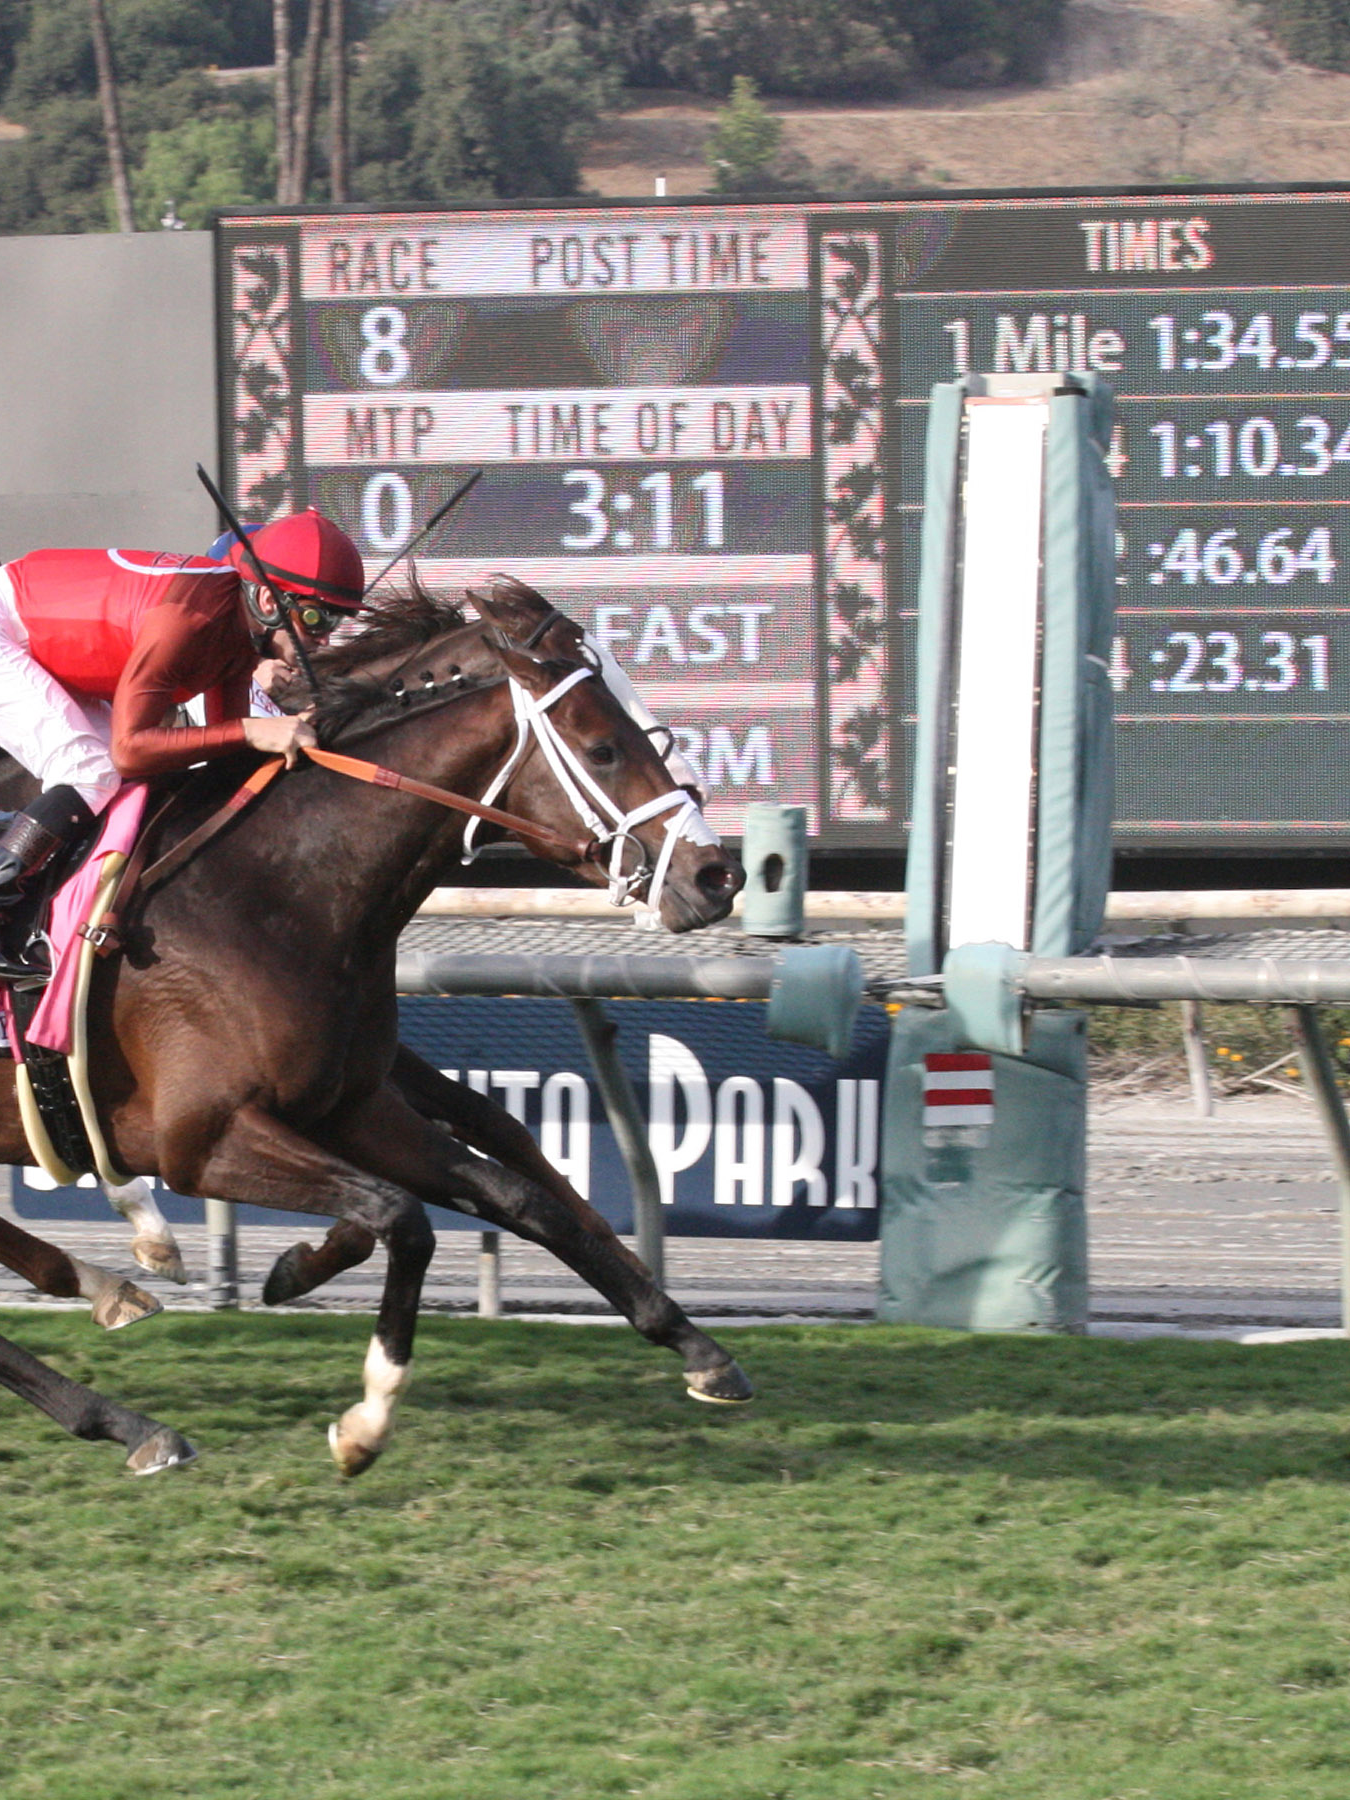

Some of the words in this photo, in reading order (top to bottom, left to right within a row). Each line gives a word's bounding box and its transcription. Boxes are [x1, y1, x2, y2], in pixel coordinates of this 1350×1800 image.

[329, 240, 439, 292] RACE
[533, 235, 636, 286] POST
[663, 231, 772, 285] TIME
[1079, 217, 1215, 272] TIMES
[360, 306, 407, 384] 8
[944, 318, 971, 373] 1
[993, 314, 1126, 372] Mile
[347, 408, 435, 459] MTP
[506, 405, 611, 456] TIME
[639, 404, 683, 453] OF
[713, 401, 793, 452] DAY
[363, 473, 412, 551] 0
[563, 470, 724, 549] 3:11
[1148, 528, 1335, 585] :46.64
[594, 604, 773, 663] FAST
[1150, 632, 1330, 692] :23.31
